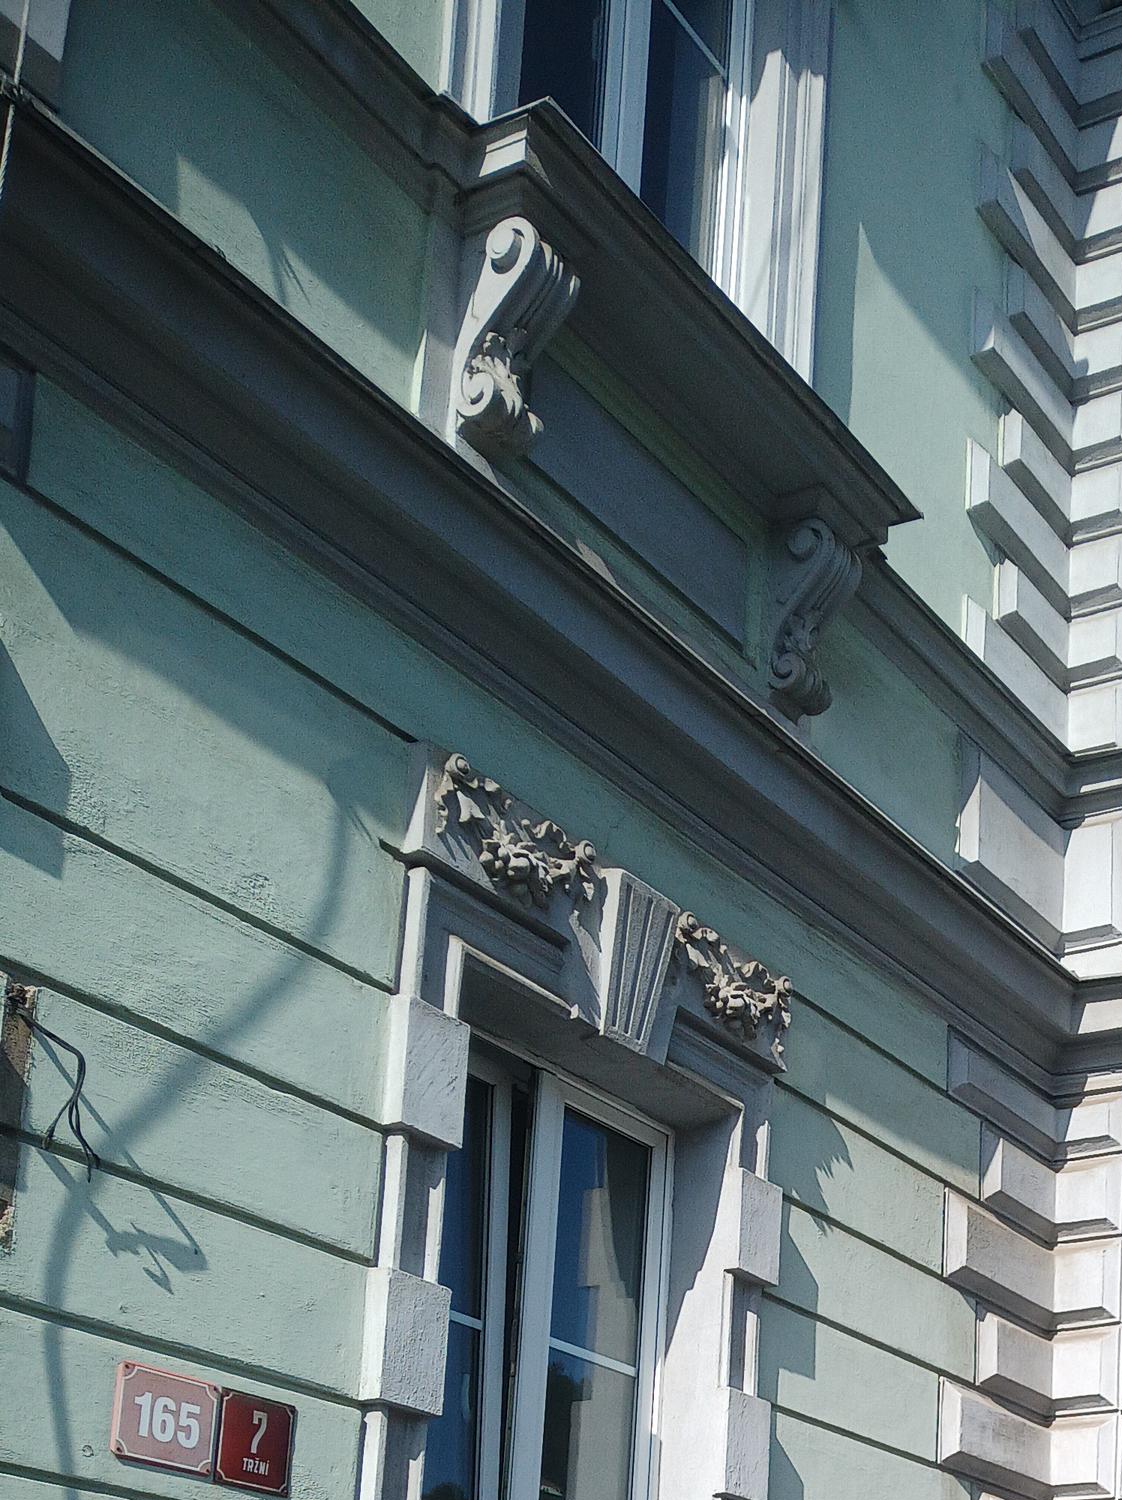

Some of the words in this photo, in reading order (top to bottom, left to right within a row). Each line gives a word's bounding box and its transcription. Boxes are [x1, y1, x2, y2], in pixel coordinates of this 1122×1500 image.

[134, 1391, 200, 1449] 165
[250, 1410, 268, 1454] 7
[242, 1457, 270, 1476] TRŽNÍ
